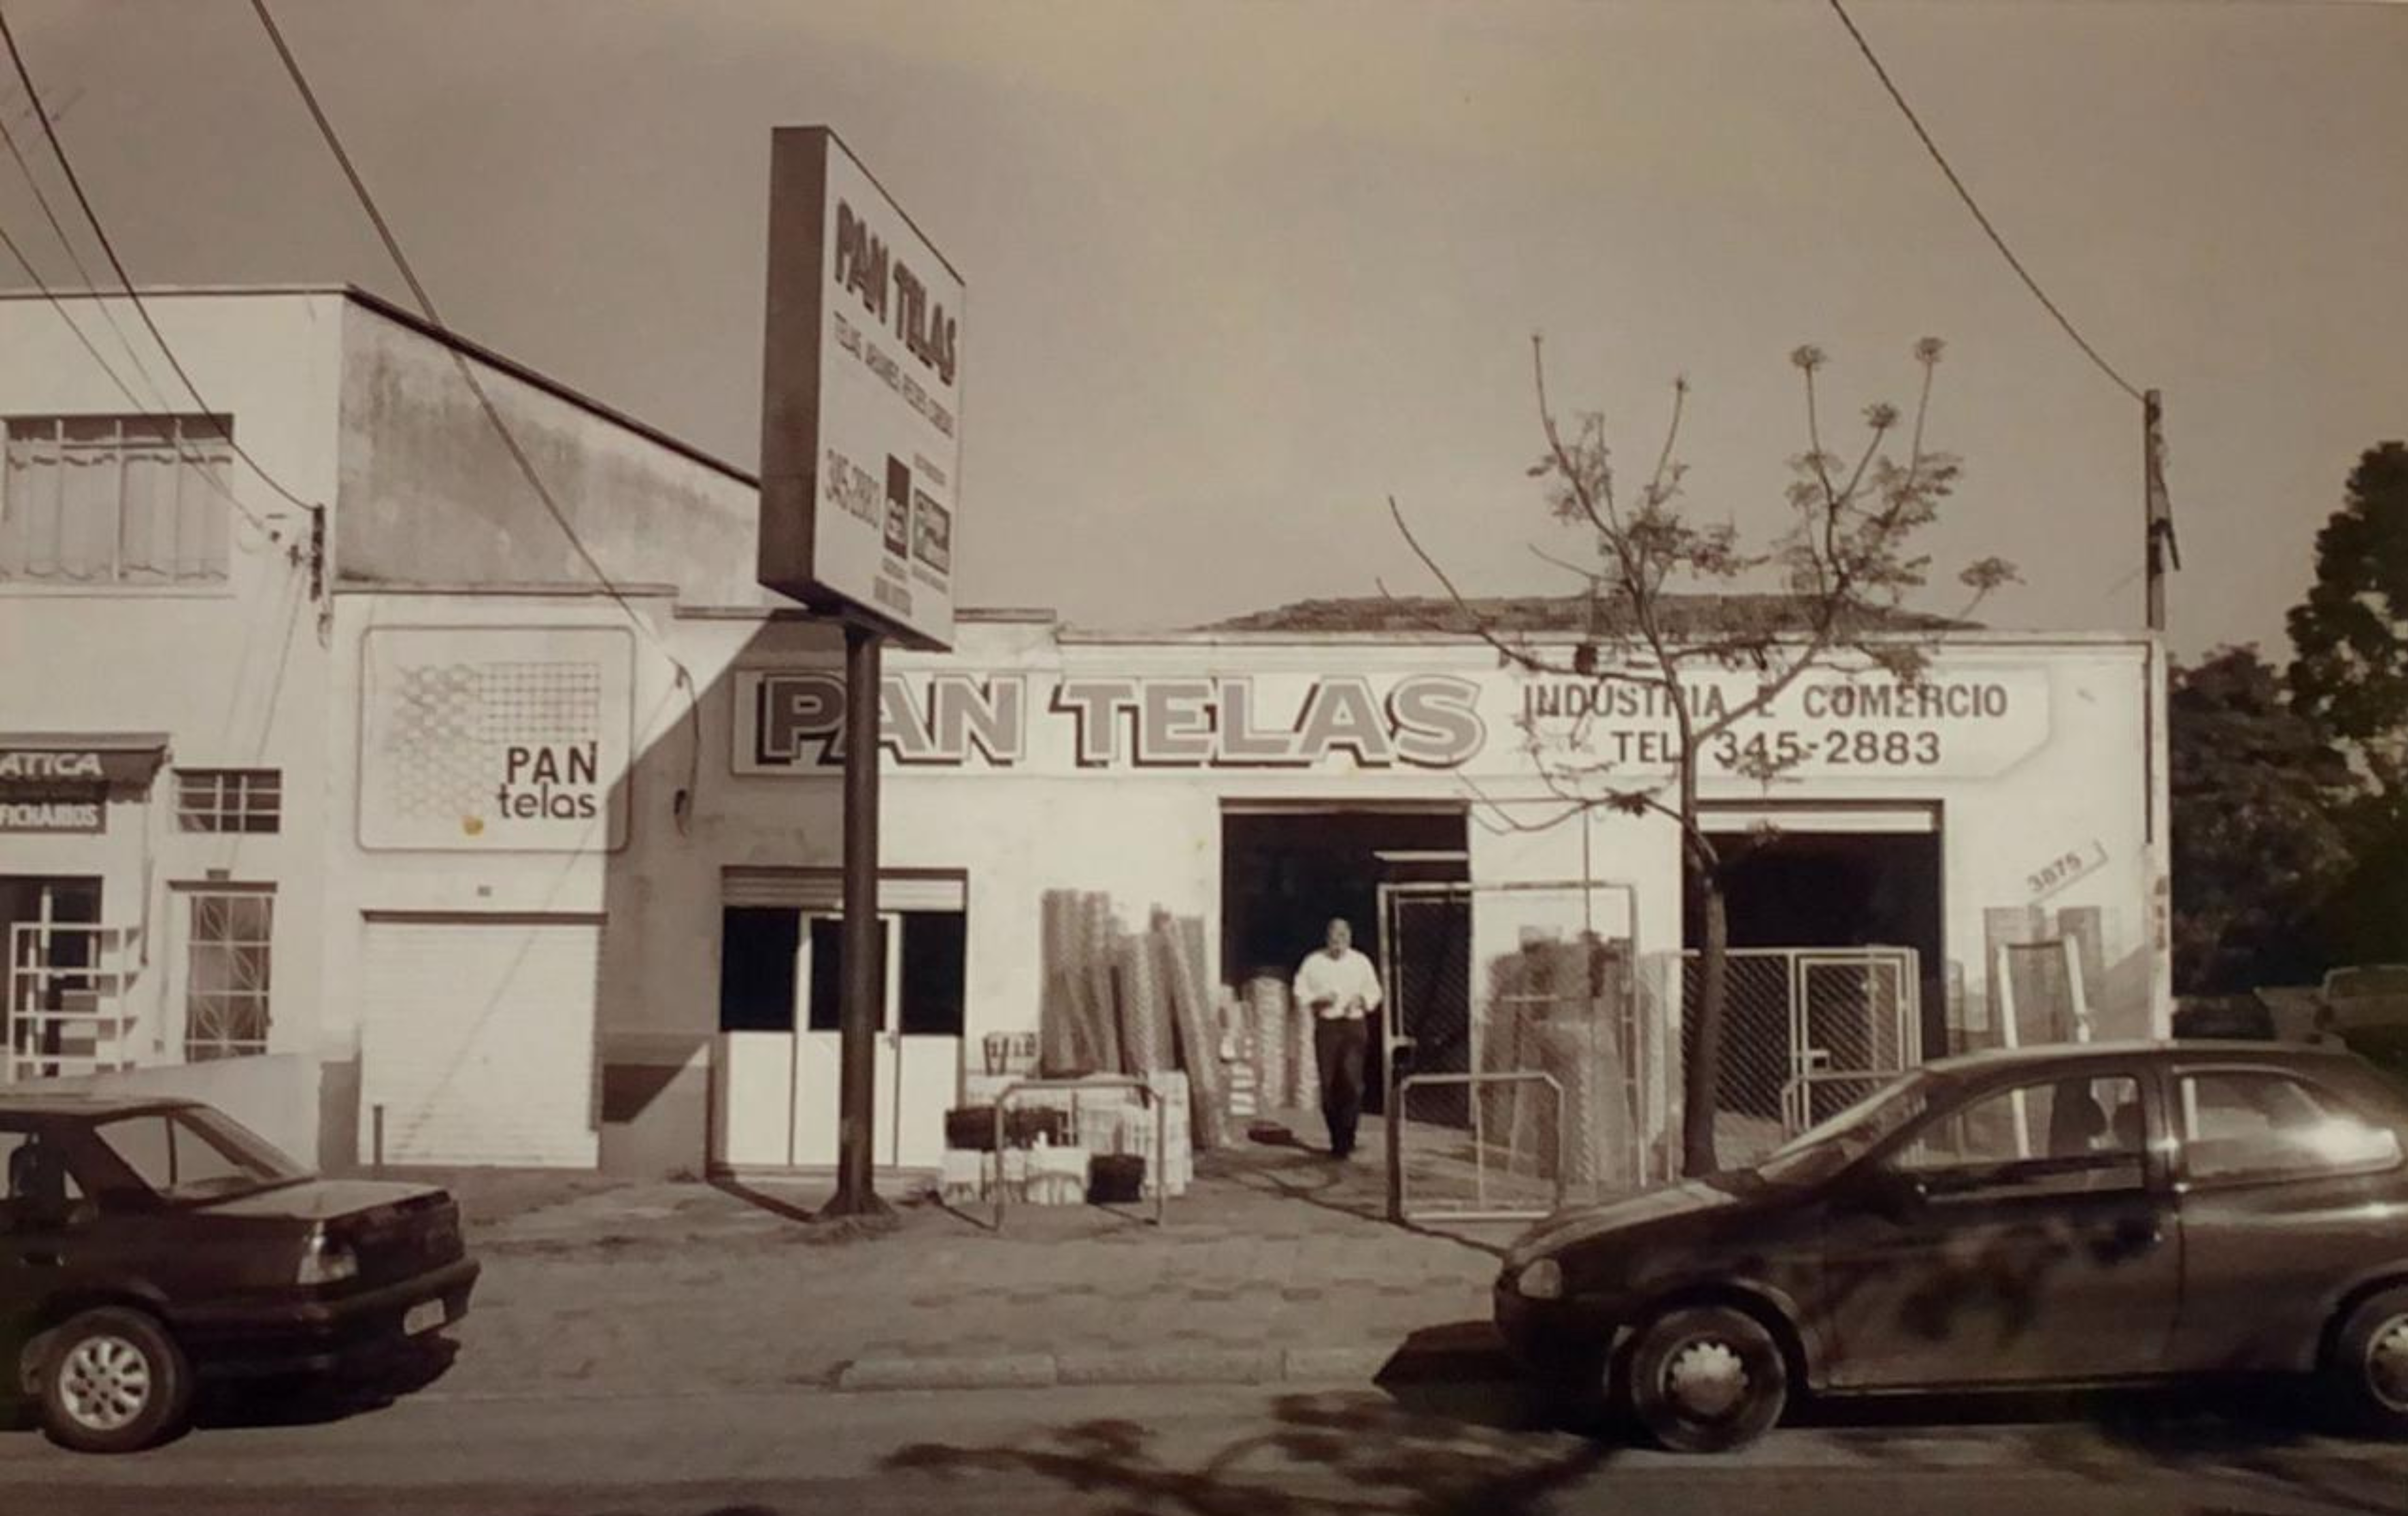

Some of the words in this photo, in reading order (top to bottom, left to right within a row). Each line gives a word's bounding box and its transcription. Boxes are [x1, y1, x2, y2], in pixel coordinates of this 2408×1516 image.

[835, 197, 888, 326] PAN
[893, 259, 956, 387] TELAS
[756, 673, 1024, 765] PAN
[1049, 674, 1487, 769] TELAS
[1803, 684, 2008, 718] COMERCIO
[507, 741, 598, 785] PAN
[1714, 729, 1940, 766] 345-2883
[497, 783, 597, 819] telas
